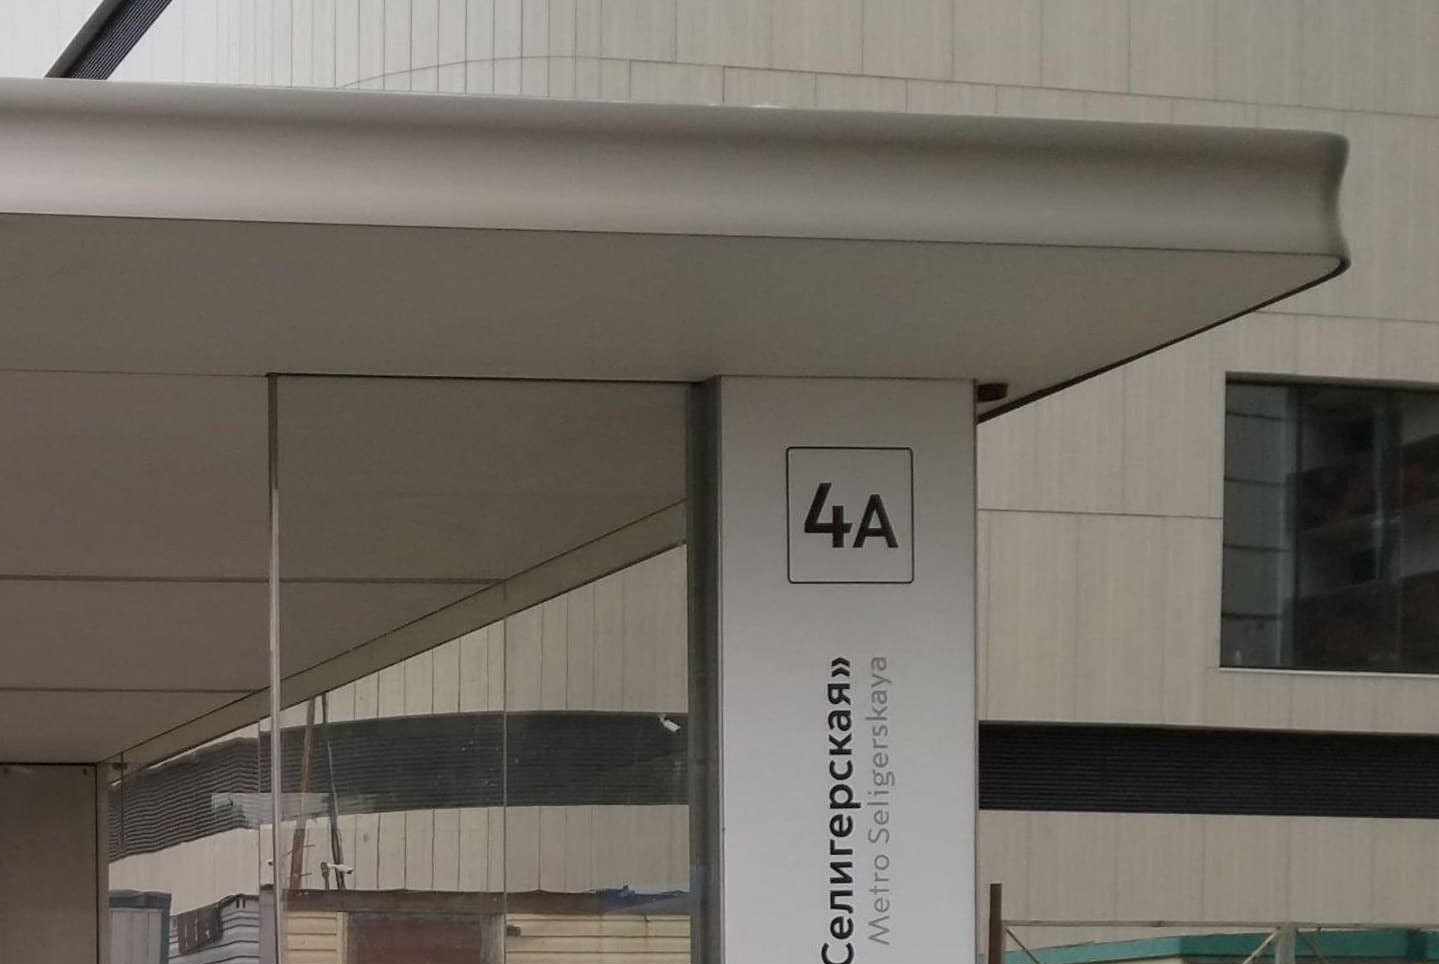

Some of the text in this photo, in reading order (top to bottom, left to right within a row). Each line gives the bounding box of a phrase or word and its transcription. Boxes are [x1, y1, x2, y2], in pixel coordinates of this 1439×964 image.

[804, 482, 898, 548] 4А
[865, 655, 896, 945] Metro Seligerskaya
